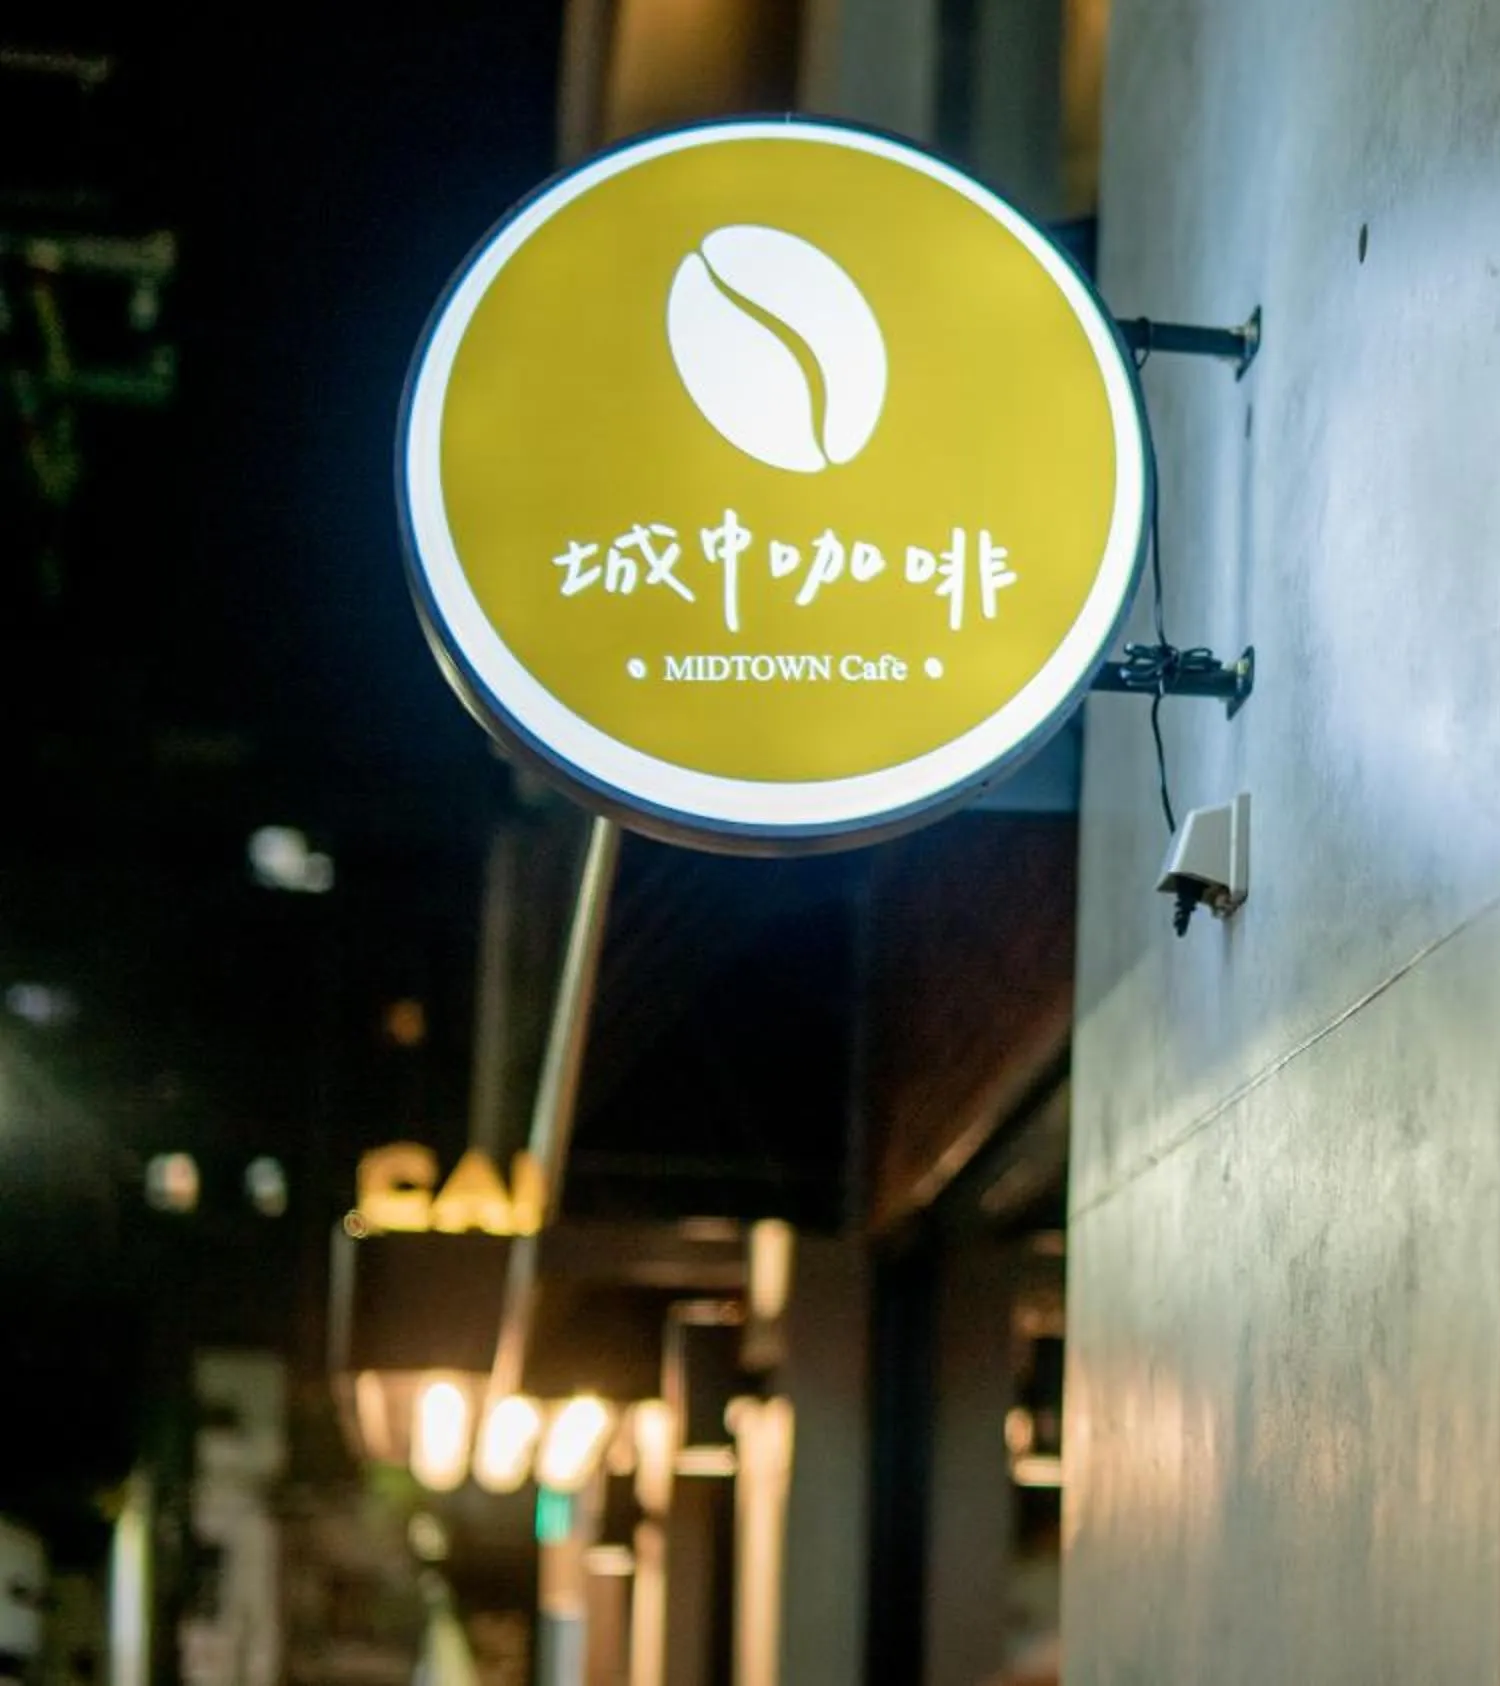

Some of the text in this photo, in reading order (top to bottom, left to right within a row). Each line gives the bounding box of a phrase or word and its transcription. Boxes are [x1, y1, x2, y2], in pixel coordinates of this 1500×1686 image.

[552, 508, 1018, 632] 城中咖啡
[664, 654, 833, 682] MIDTOWN
